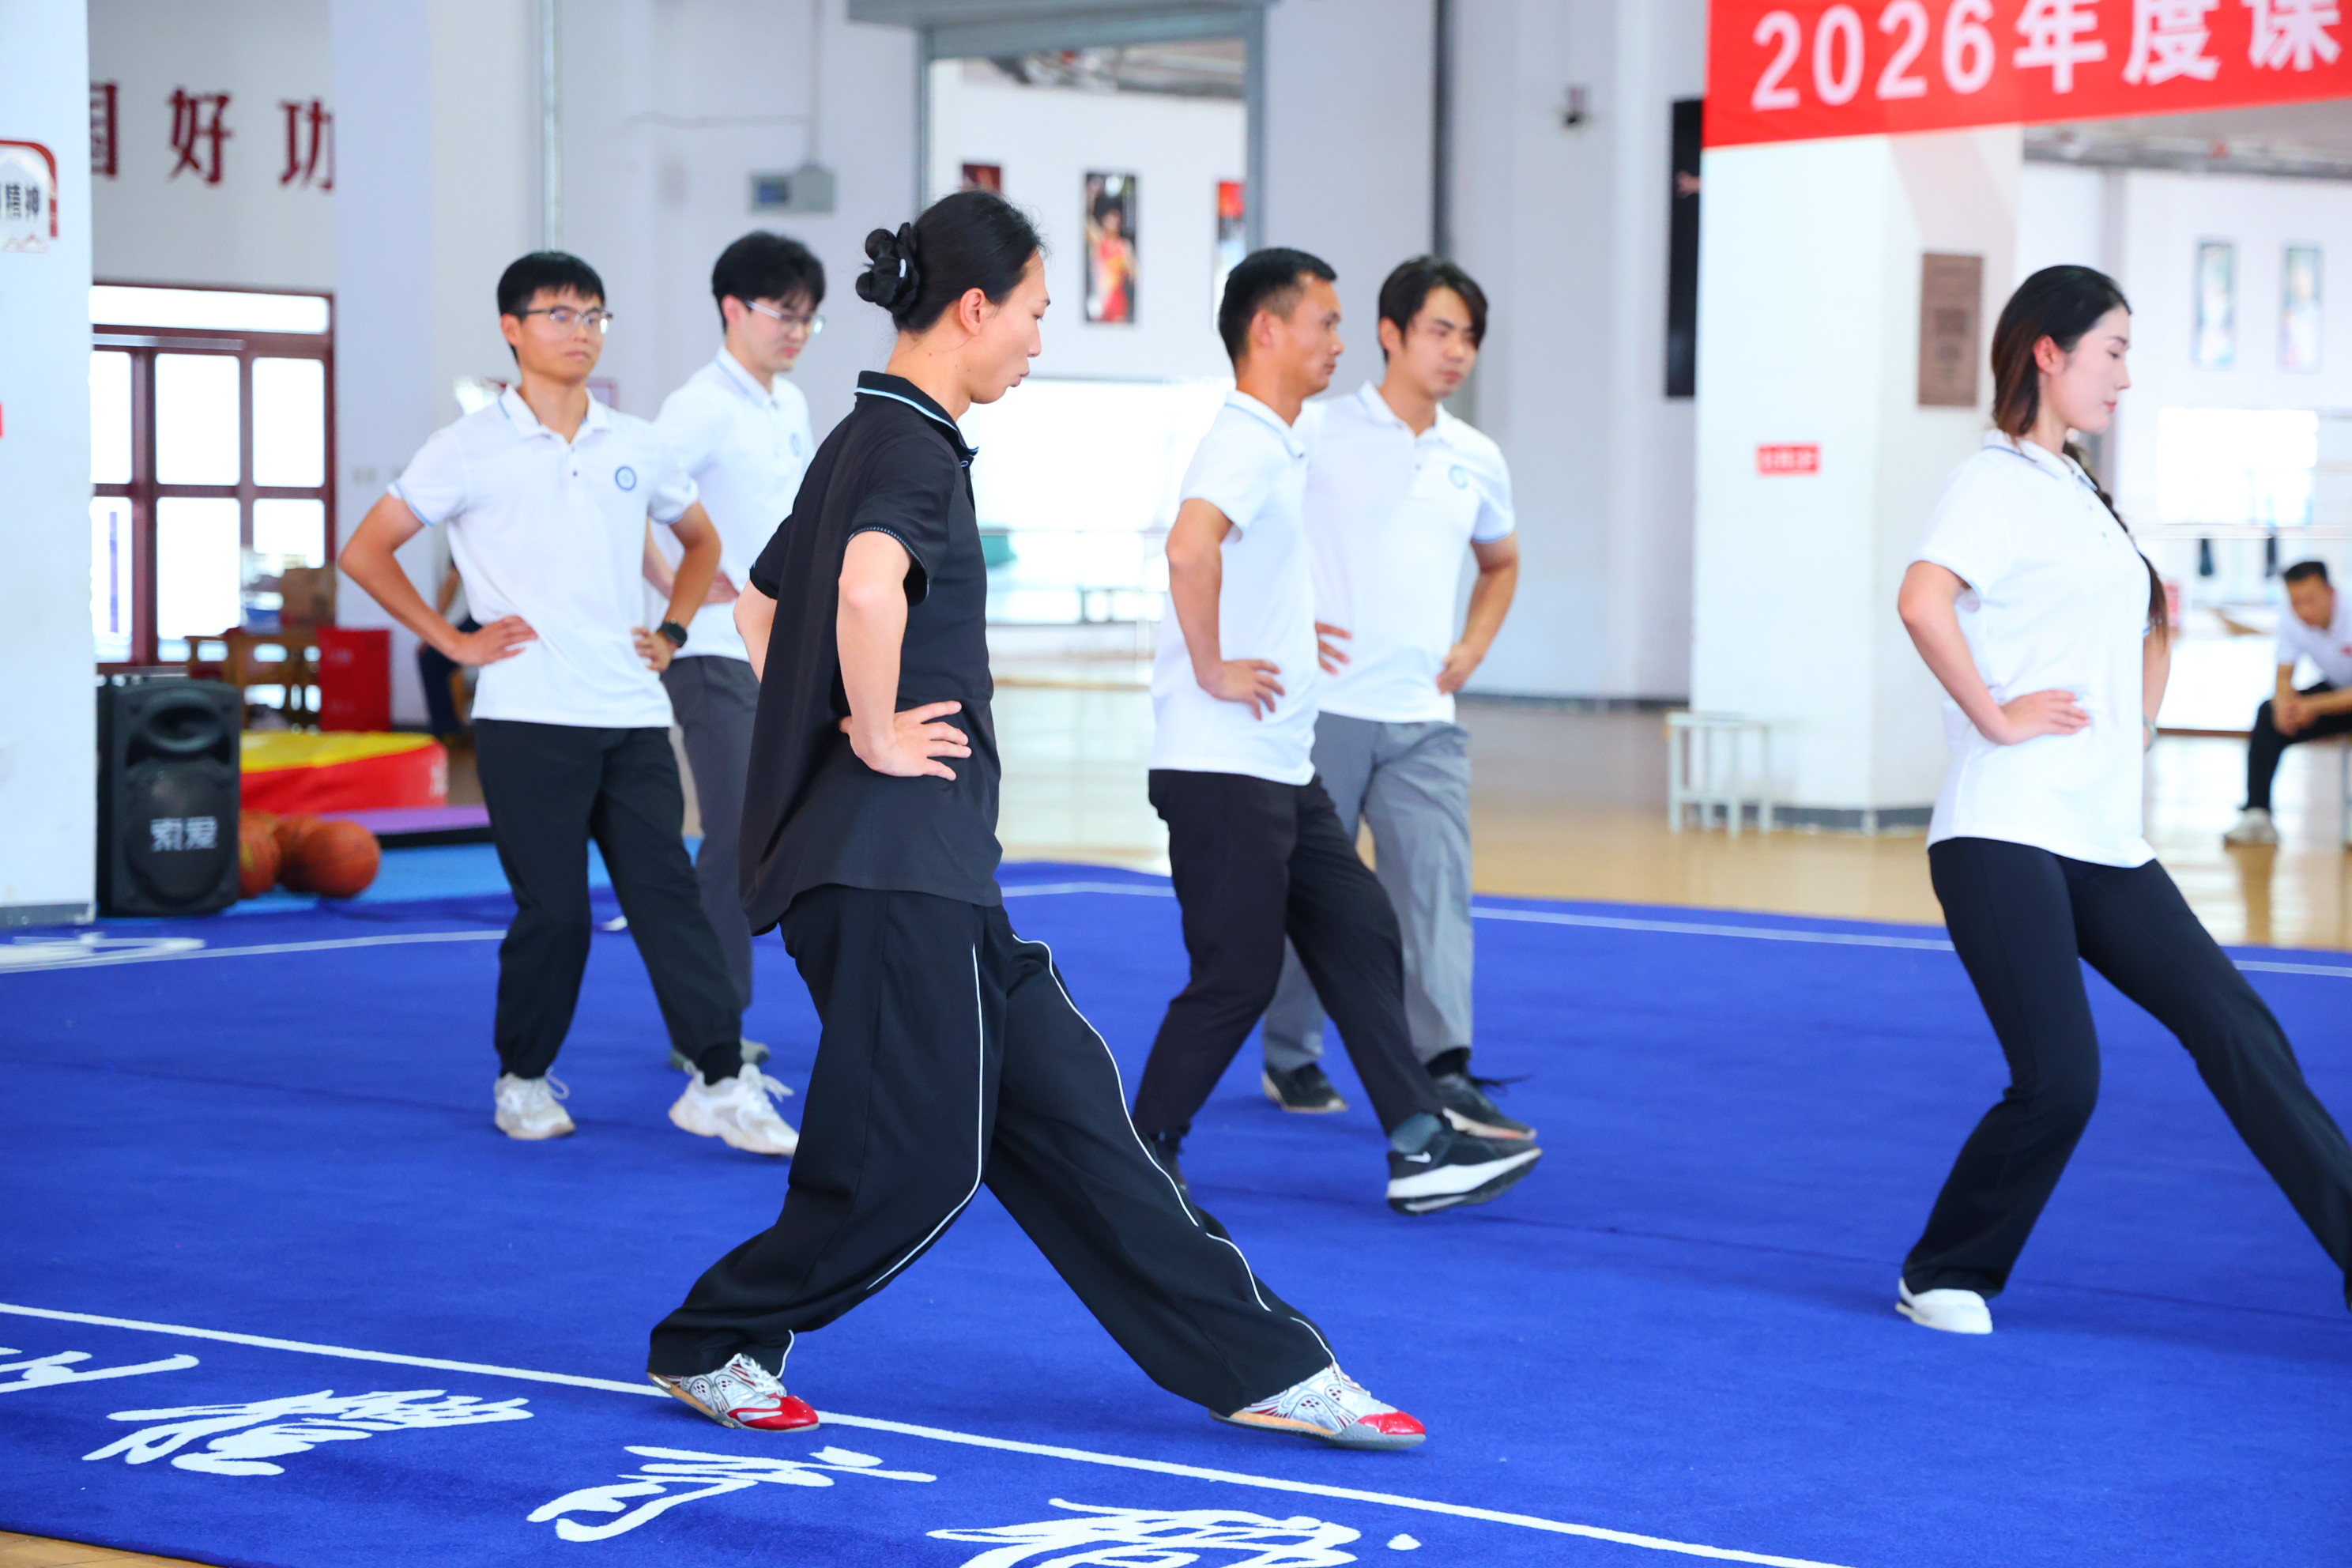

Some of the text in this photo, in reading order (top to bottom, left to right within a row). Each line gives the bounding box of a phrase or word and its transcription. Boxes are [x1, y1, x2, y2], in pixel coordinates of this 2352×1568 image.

[1751, 0, 2343, 111] 2026年度课
[150, 816, 217, 852] 索爱
